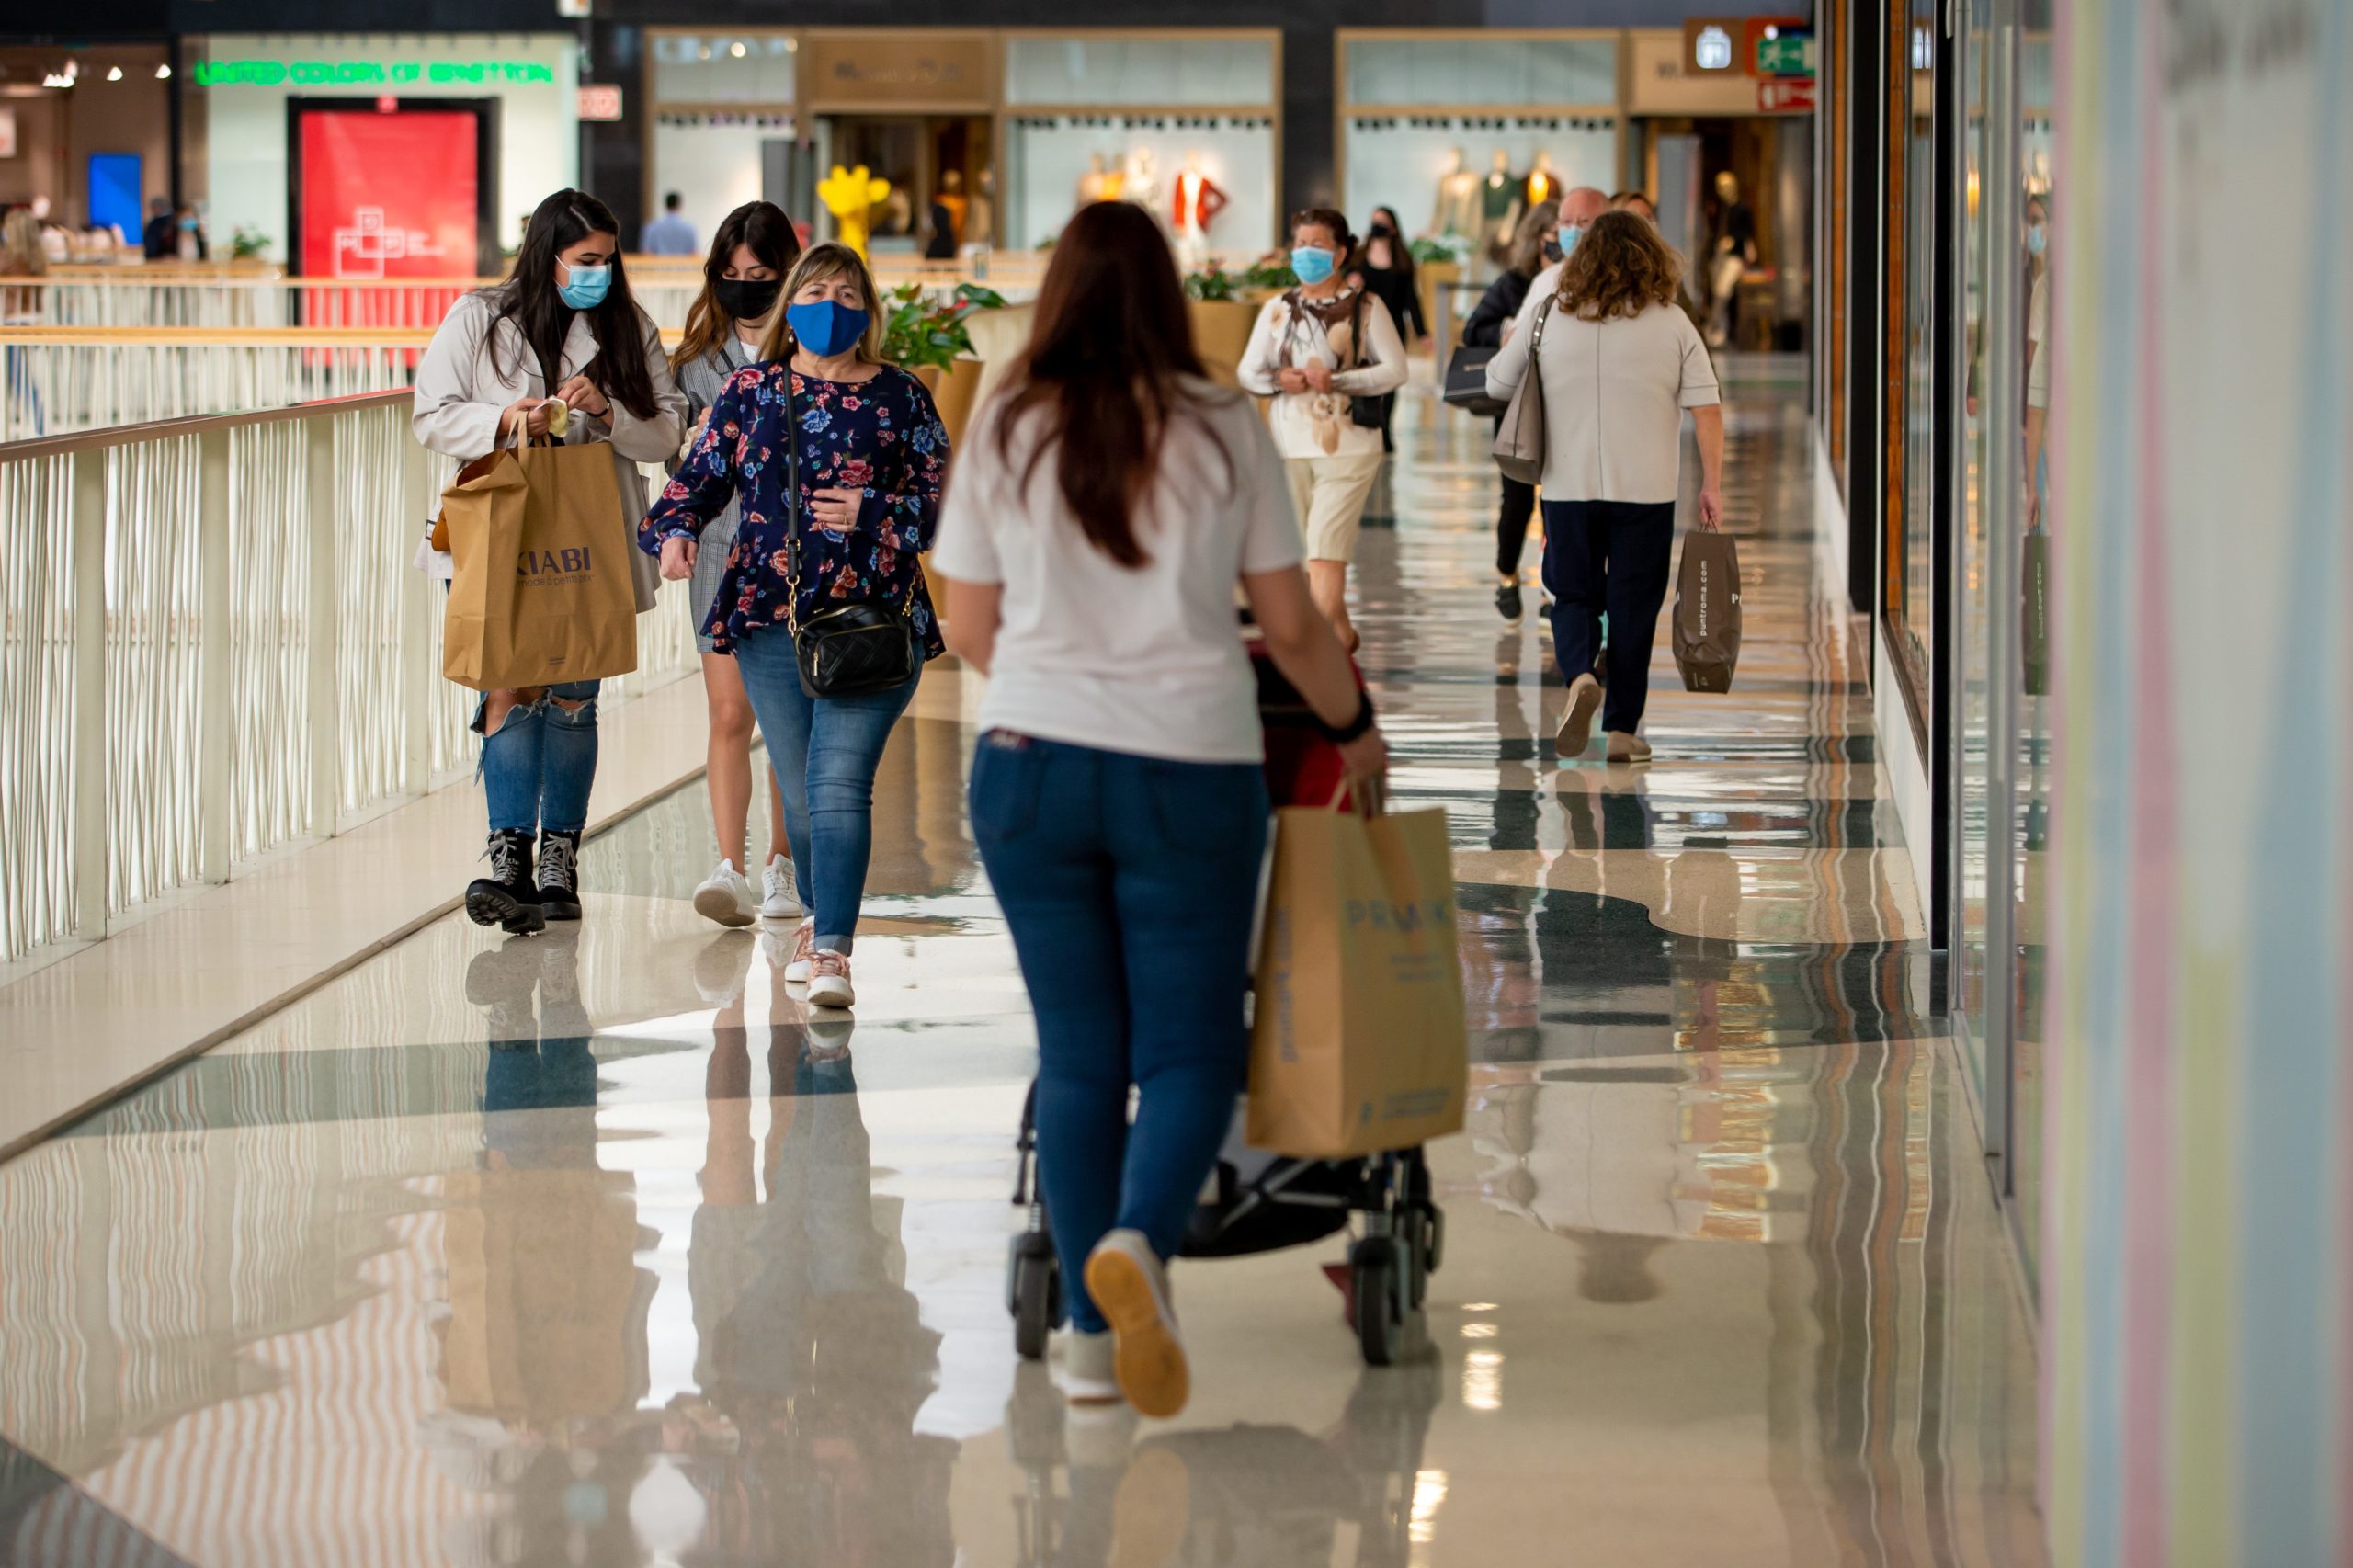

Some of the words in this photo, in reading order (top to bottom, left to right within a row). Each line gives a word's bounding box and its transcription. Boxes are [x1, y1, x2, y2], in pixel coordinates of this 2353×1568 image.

[194, 60, 286, 85] UNITED
[391, 62, 421, 84] OF
[1699, 561, 1708, 637] puntroma.com
